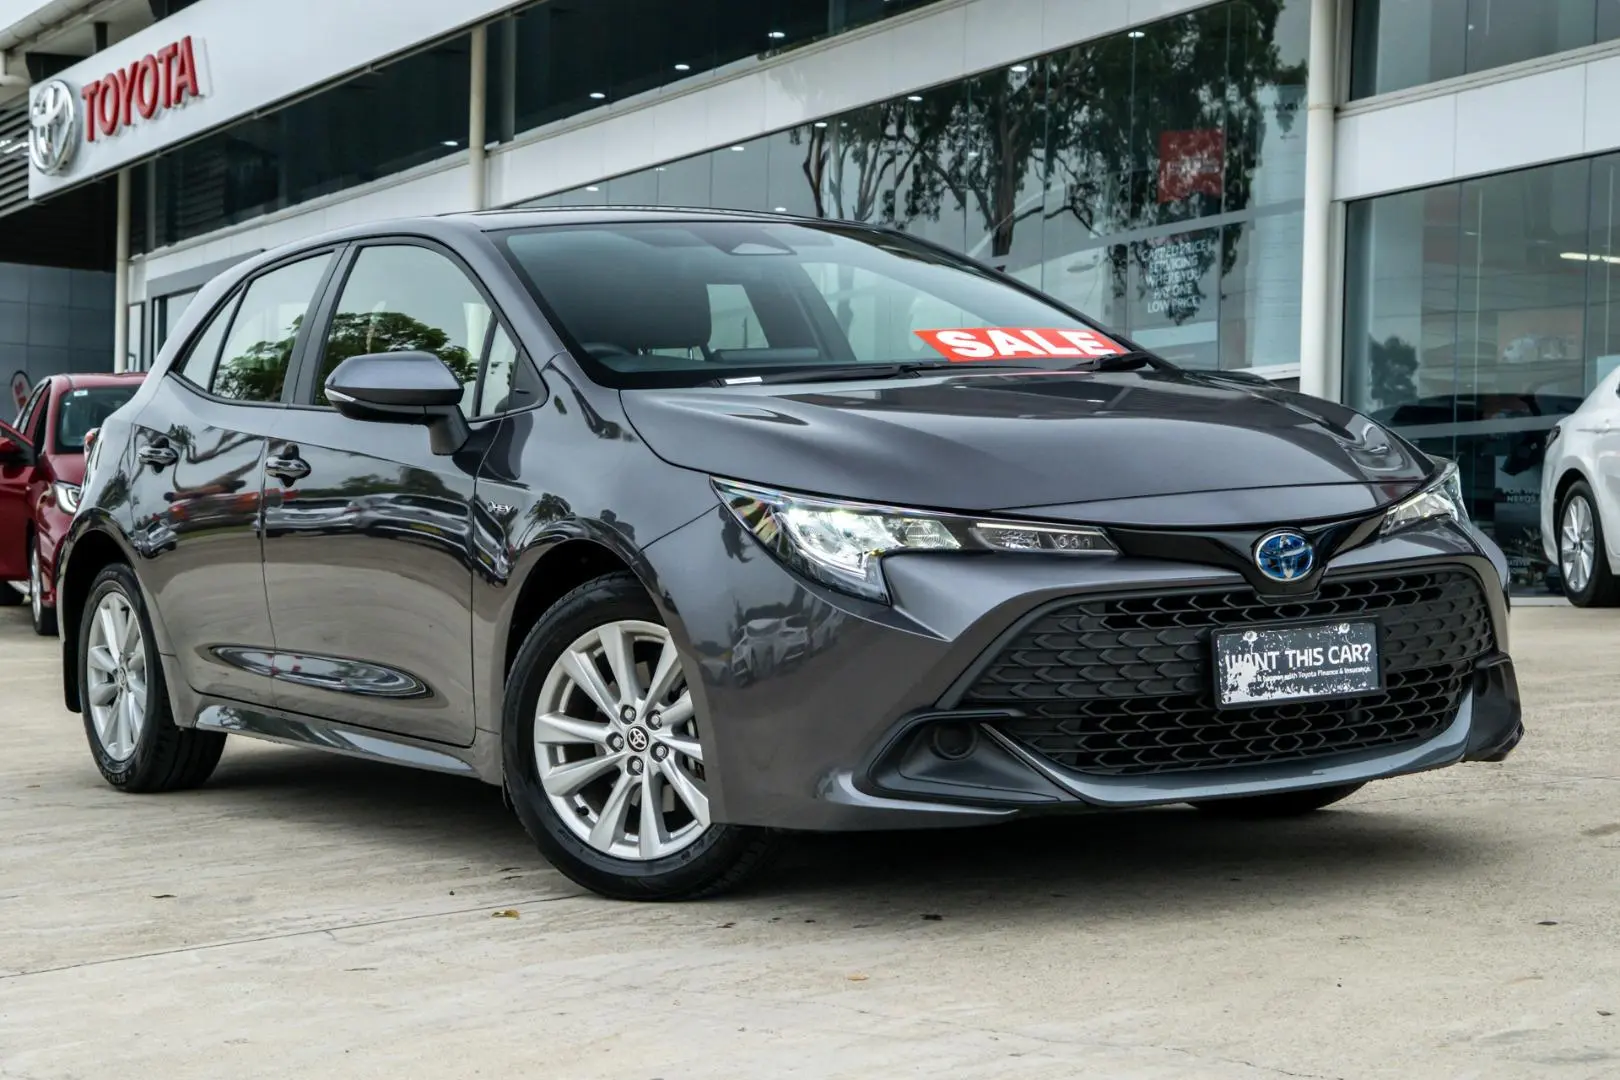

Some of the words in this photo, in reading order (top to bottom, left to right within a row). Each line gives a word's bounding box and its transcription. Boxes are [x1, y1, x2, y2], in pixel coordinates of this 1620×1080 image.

[81, 35, 199, 142] TOYOTA
[1147, 299, 1170, 314] LOW
[935, 330, 1118, 357] SALE
[1225, 652, 1280, 672] WANT
[1285, 648, 1323, 668] THIS
[1328, 643, 1372, 665] CAR?
[1298, 670, 1317, 678] Toyota
[1317, 668, 1339, 677] Finance
